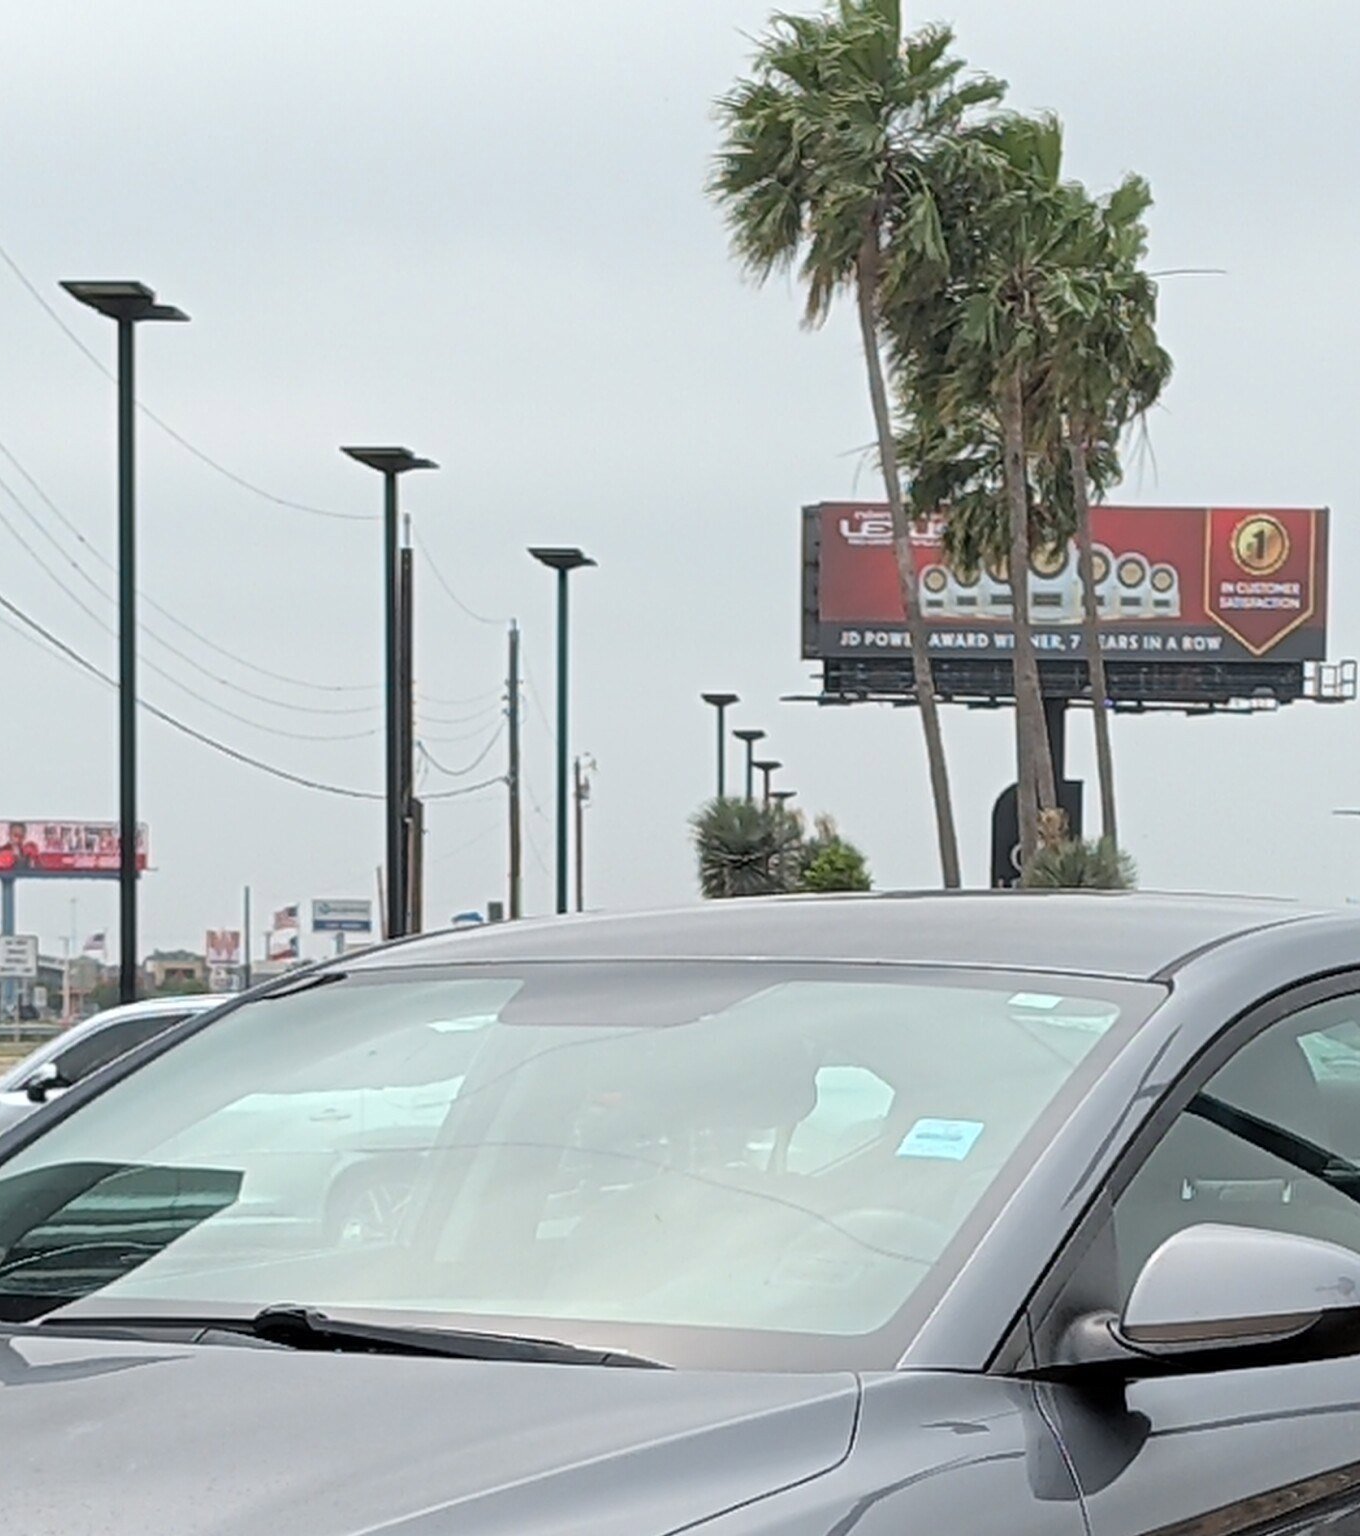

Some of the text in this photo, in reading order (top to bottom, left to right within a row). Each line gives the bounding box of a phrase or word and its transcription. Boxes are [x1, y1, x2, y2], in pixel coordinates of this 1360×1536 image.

[1252, 529, 1265, 560] 1
[841, 631, 861, 647] JD
[929, 632, 989, 648] AWARD
[1070, 634, 1081, 649] 7
[1098, 635, 1138, 650] EARS
[1143, 636, 1162, 650] IN
[1166, 636, 1178, 650] A
[1182, 636, 1222, 650] ROW
